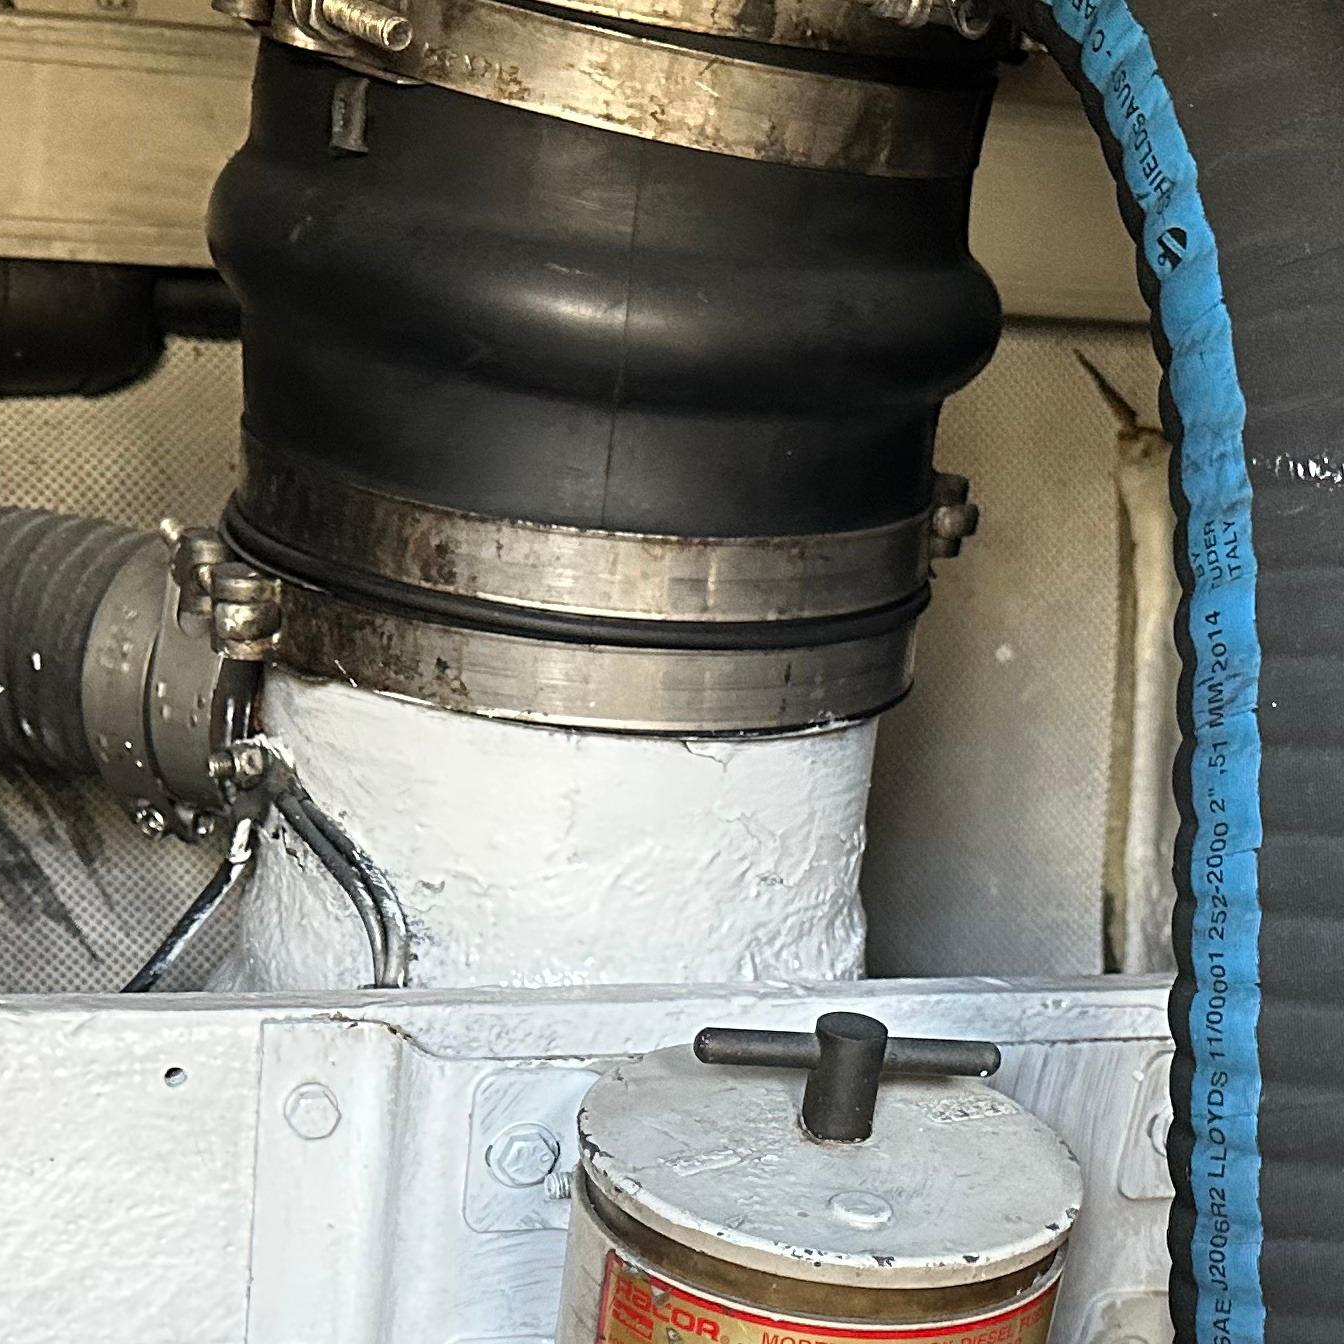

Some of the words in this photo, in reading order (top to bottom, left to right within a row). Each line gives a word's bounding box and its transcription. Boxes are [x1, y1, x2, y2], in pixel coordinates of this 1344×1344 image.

[1223, 520, 1242, 580] ITALY
[1205, 610, 1229, 673] 2014
[1206, 821, 1229, 941] 252-2000
[1206, 952, 1229, 1059] 11/00001
[1208, 1070, 1229, 1179] LLOYDS
[1208, 1187, 1231, 1291] J2006R2
